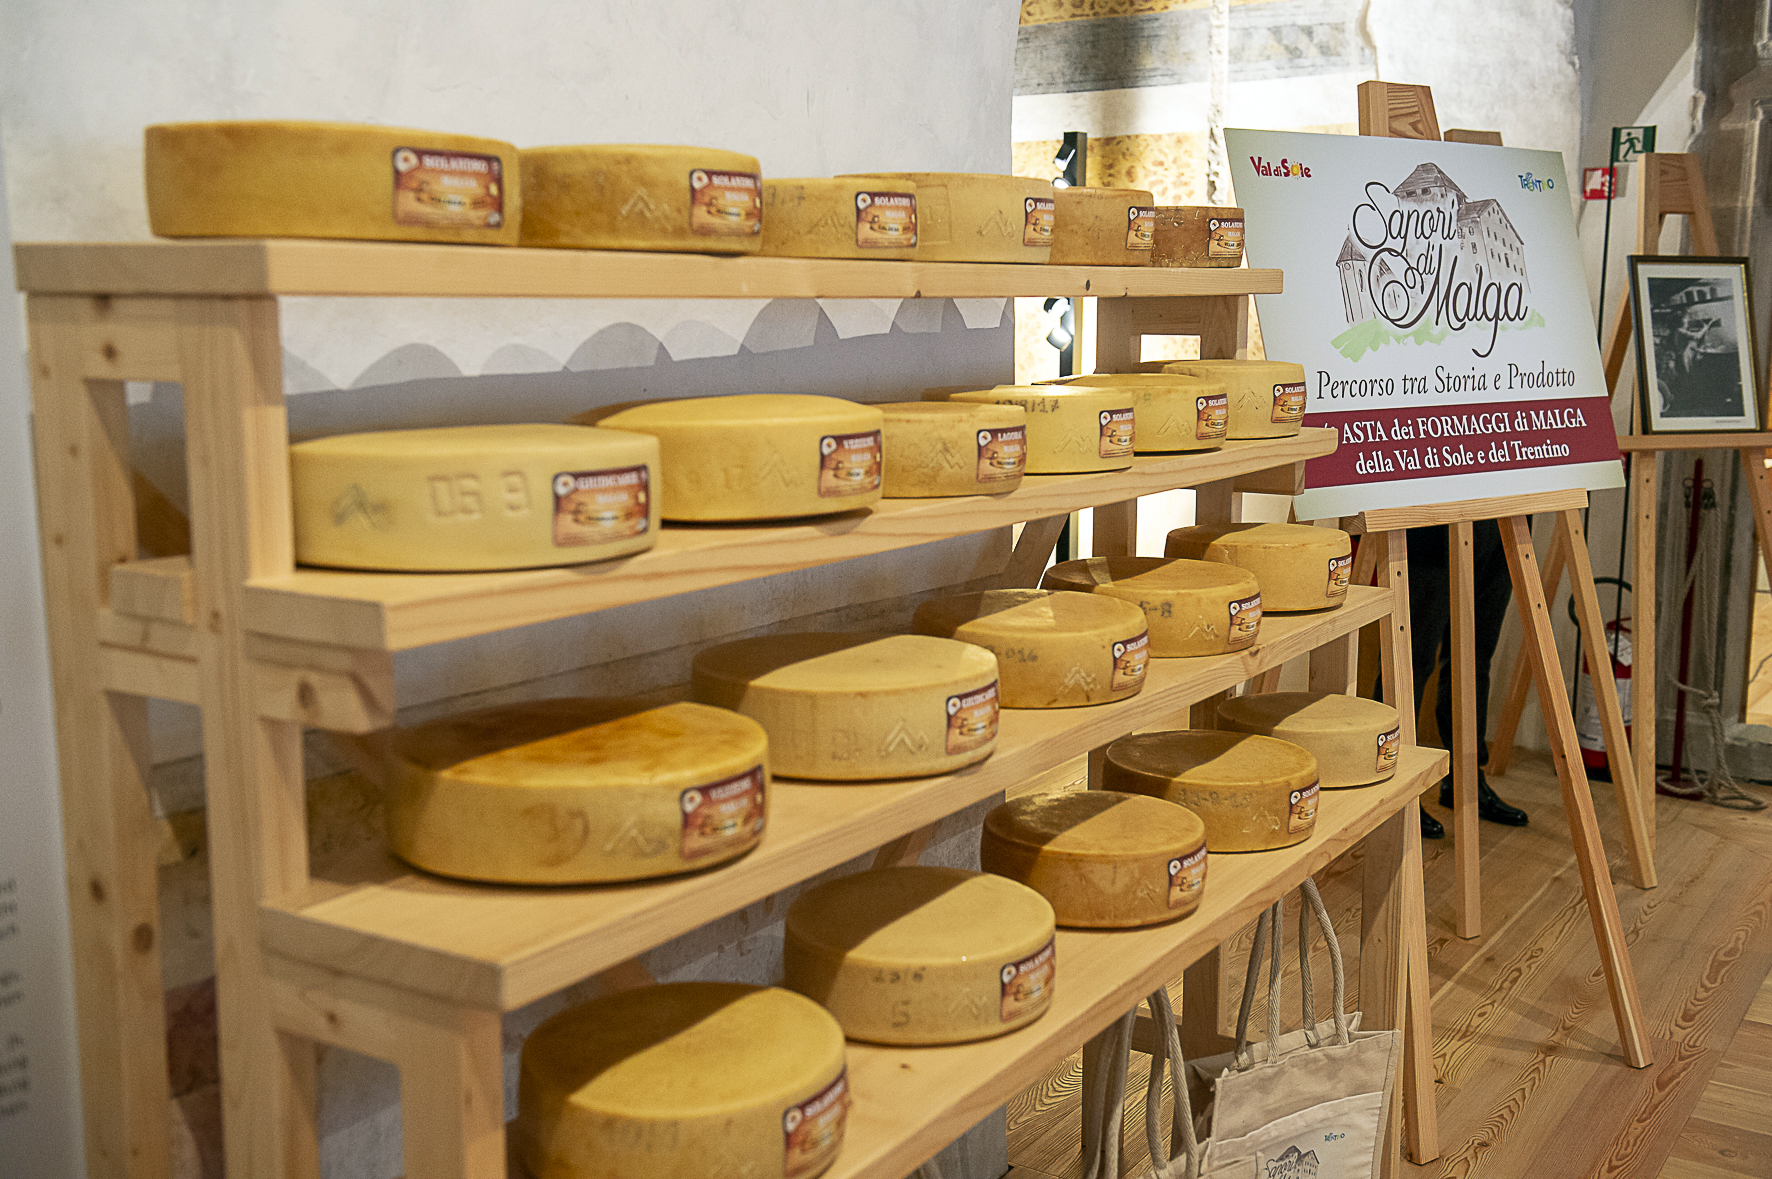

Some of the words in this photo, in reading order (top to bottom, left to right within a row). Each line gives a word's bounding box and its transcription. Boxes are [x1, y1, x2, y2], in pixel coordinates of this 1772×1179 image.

[1352, 181, 1458, 257] Sapori
[1416, 240, 1435, 276] di
[1368, 243, 1528, 358] Malga
[1316, 370, 1395, 400] Percorso
[1402, 373, 1428, 395] tra
[1434, 365, 1488, 394] Storia
[1493, 371, 1501, 384] e
[1507, 360, 1575, 390] Prodotto
[1341, 420, 1389, 444] ASTA
[1390, 418, 1416, 441] dei
[1416, 412, 1512, 439] FORMAGGI
[1514, 410, 1528, 431] di
[1529, 407, 1587, 430] MALGA
[1355, 452, 1395, 475] della
[1394, 448, 1422, 471] Val
[1424, 447, 1441, 468] di
[1442, 444, 1475, 467] Sole
[1477, 450, 1486, 464] e
[1490, 441, 1511, 462] del
[1510, 438, 1570, 461] Trentino
